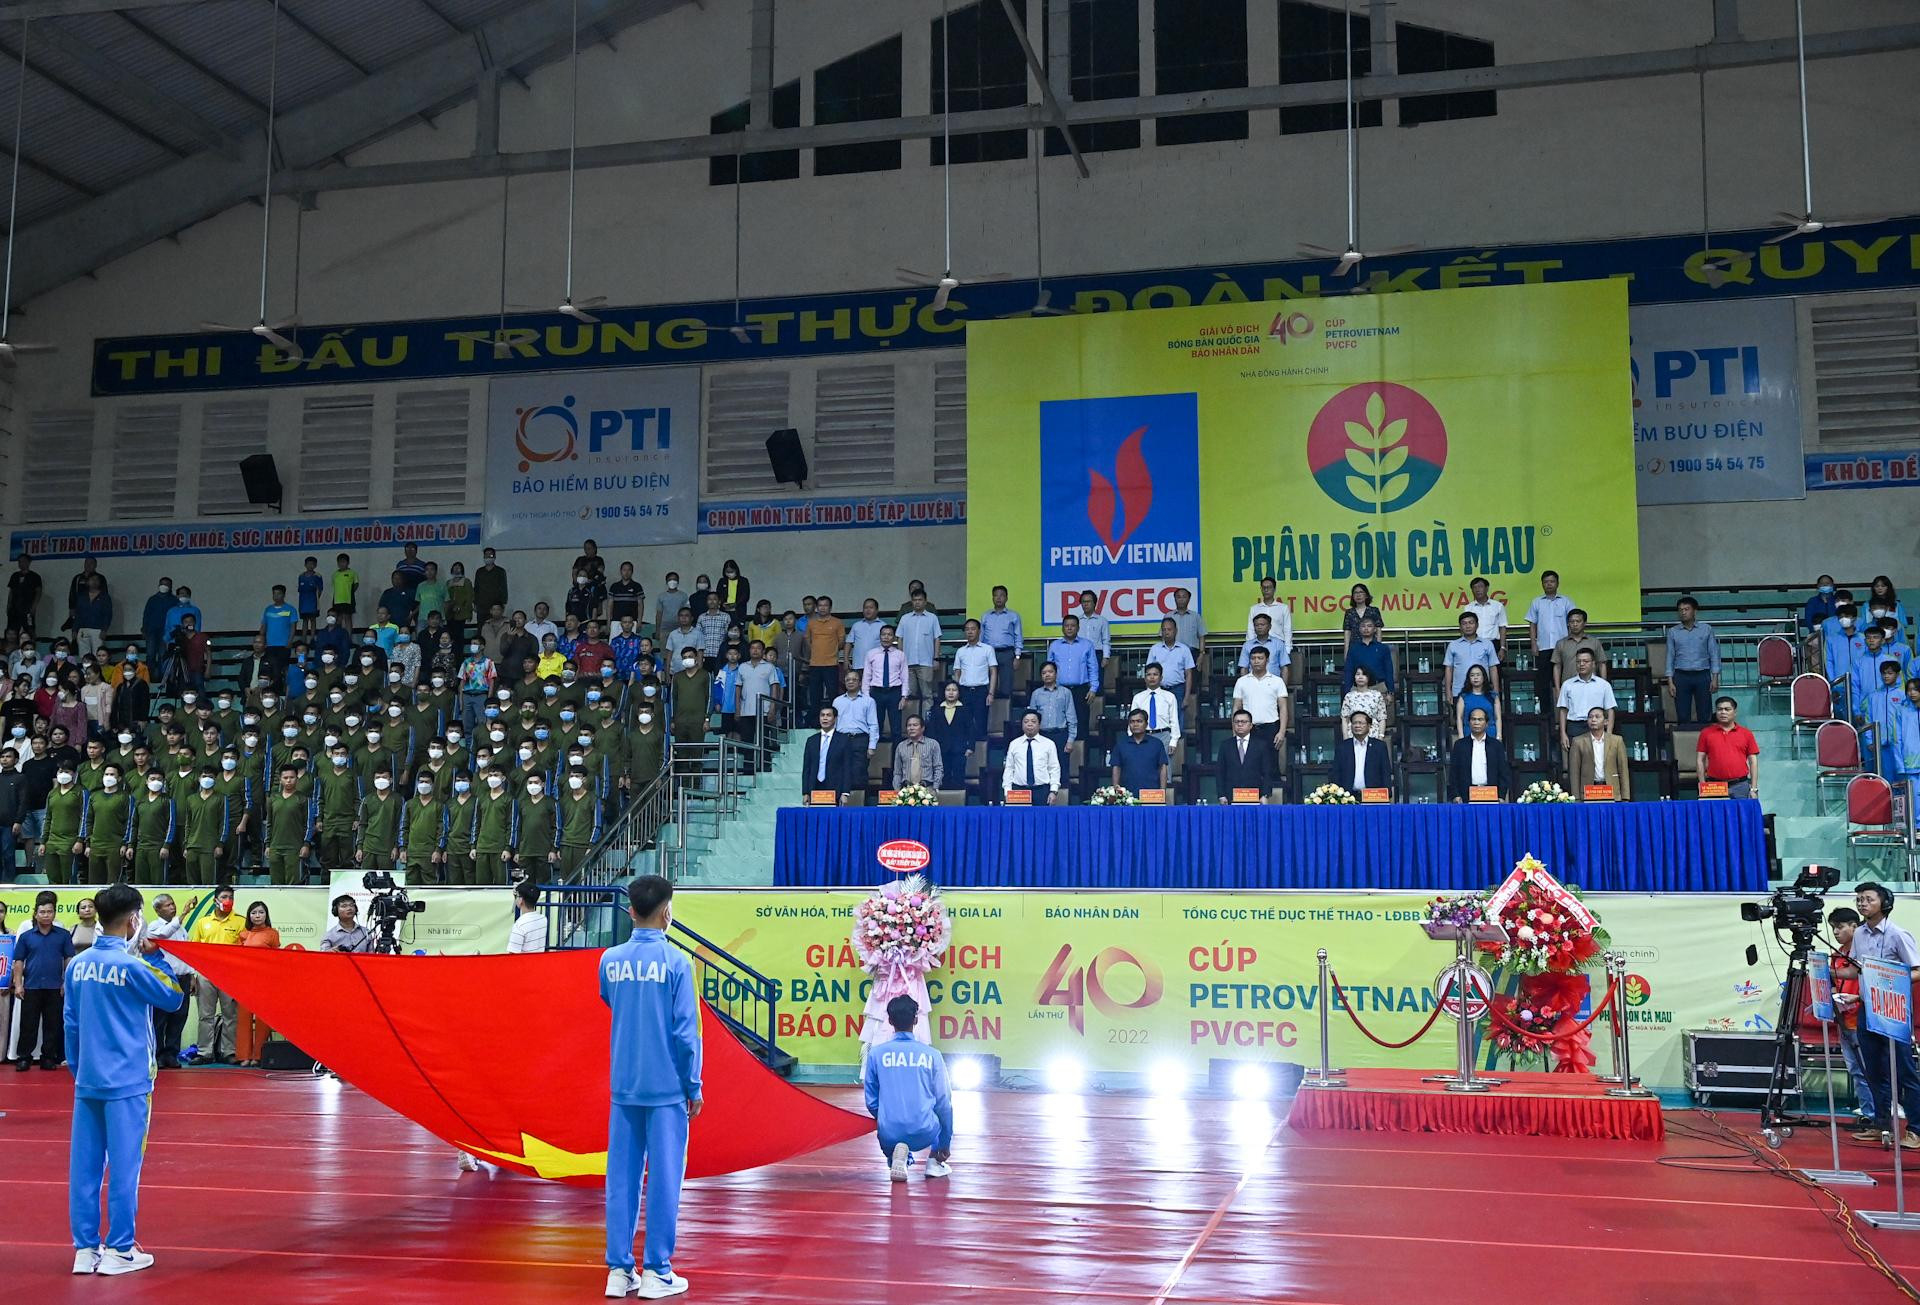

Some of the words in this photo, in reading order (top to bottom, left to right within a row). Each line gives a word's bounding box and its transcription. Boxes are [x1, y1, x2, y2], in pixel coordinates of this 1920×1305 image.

[108, 346, 222, 380] THI
[256, 329, 409, 374] ĐẤU
[444, 317, 708, 361] TRUNG
[745, 297, 969, 347] THỰC
[1683, 234, 1920, 285] QUY
[1244, 335, 1260, 344] GIA
[1268, 312, 1315, 345] 40
[1325, 326, 1400, 339] PETROVIETNAM
[1325, 340, 1357, 350] PVCFC
[1654, 346, 1760, 398] PTI
[589, 407, 671, 452] PTI
[1664, 423, 1707, 440] BƯU
[1713, 420, 1763, 441] ĐIỆN
[1669, 458, 1702, 473] 1900
[1706, 457, 1723, 472] 54
[1727, 456, 1744, 471] 54
[1748, 455, 1765, 470] 75
[512, 476, 545, 494] BẢO
[549, 472, 588, 492] HIỂM
[594, 474, 627, 491] BƯU
[631, 472, 670, 491] ĐIỆN
[595, 507, 620, 519] 1900
[623, 505, 637, 518] 54
[639, 505, 653, 517] 54
[656, 504, 669, 516] 75
[708, 510, 746, 531] CHỌN
[750, 505, 782, 525] MÔN
[815, 506, 851, 523] THAO
[878, 501, 905, 524] TẬP
[909, 499, 953, 523] LUYỆN
[50, 537, 85, 552] THAO
[90, 536, 128, 550] MANG
[133, 535, 152, 552] LẠI
[158, 531, 185, 549] SỨC
[232, 528, 260, 546] SỨC
[264, 526, 301, 545] KHỎE
[343, 520, 392, 543] NGUỒN
[396, 520, 434, 541] SÁNG
[439, 523, 467, 542] TẠO
[1051, 542, 1193, 566] PETROVIETNAM
[1232, 526, 1320, 582] PHÂN
[1331, 523, 1396, 580] BÓN
[1408, 520, 1453, 578] CÀ
[1462, 526, 1535, 575] MAU
[1381, 588, 1432, 611] MÙA
[1439, 587, 1508, 609] VÀG
[756, 905, 773, 917] SỞ
[774, 906, 798, 917] VĂN
[800, 904, 828, 919] HÓA,
[959, 907, 979, 918] GIA
[983, 907, 1002, 918] LAI
[1045, 905, 1071, 918] BÁO
[1073, 906, 1110, 918] NHÂN
[1113, 906, 1139, 919] DÂN
[1183, 906, 1217, 920] TỔNG
[1220, 909, 1247, 922] CỤC
[1250, 906, 1275, 920] THỂ
[1278, 909, 1306, 923] DỤC
[1308, 906, 1334, 921] THỂ
[1337, 910, 1373, 921] THAO
[1385, 910, 1420, 921] LĐBB
[427, 926, 440, 935] Nhà
[452, 926, 462, 936] trợ
[806, 938, 864, 968] GIẢ
[1188, 939, 1257, 972] CÚP
[1629, 950, 1655, 958] chính
[73, 961, 98, 982] GIA
[98, 963, 127, 987] LAI
[605, 960, 635, 983] GIA
[636, 960, 667, 983] LAI
[791, 972, 850, 1002] BÀN
[951, 980, 1003, 1005] GIA
[1033, 943, 1164, 1037] 40
[778, 1006, 837, 1038] BÁO
[939, 1009, 1002, 1040] DÂN
[1028, 1009, 1045, 1019] LẦN
[1641, 1009, 1652, 1022] CÀ
[1655, 1011, 1672, 1023] MAU
[1108, 1029, 1149, 1044] 2022
[1190, 1019, 1297, 1047] PVCFC
[882, 1051, 907, 1068] GIA
[909, 1052, 933, 1070] LAI
